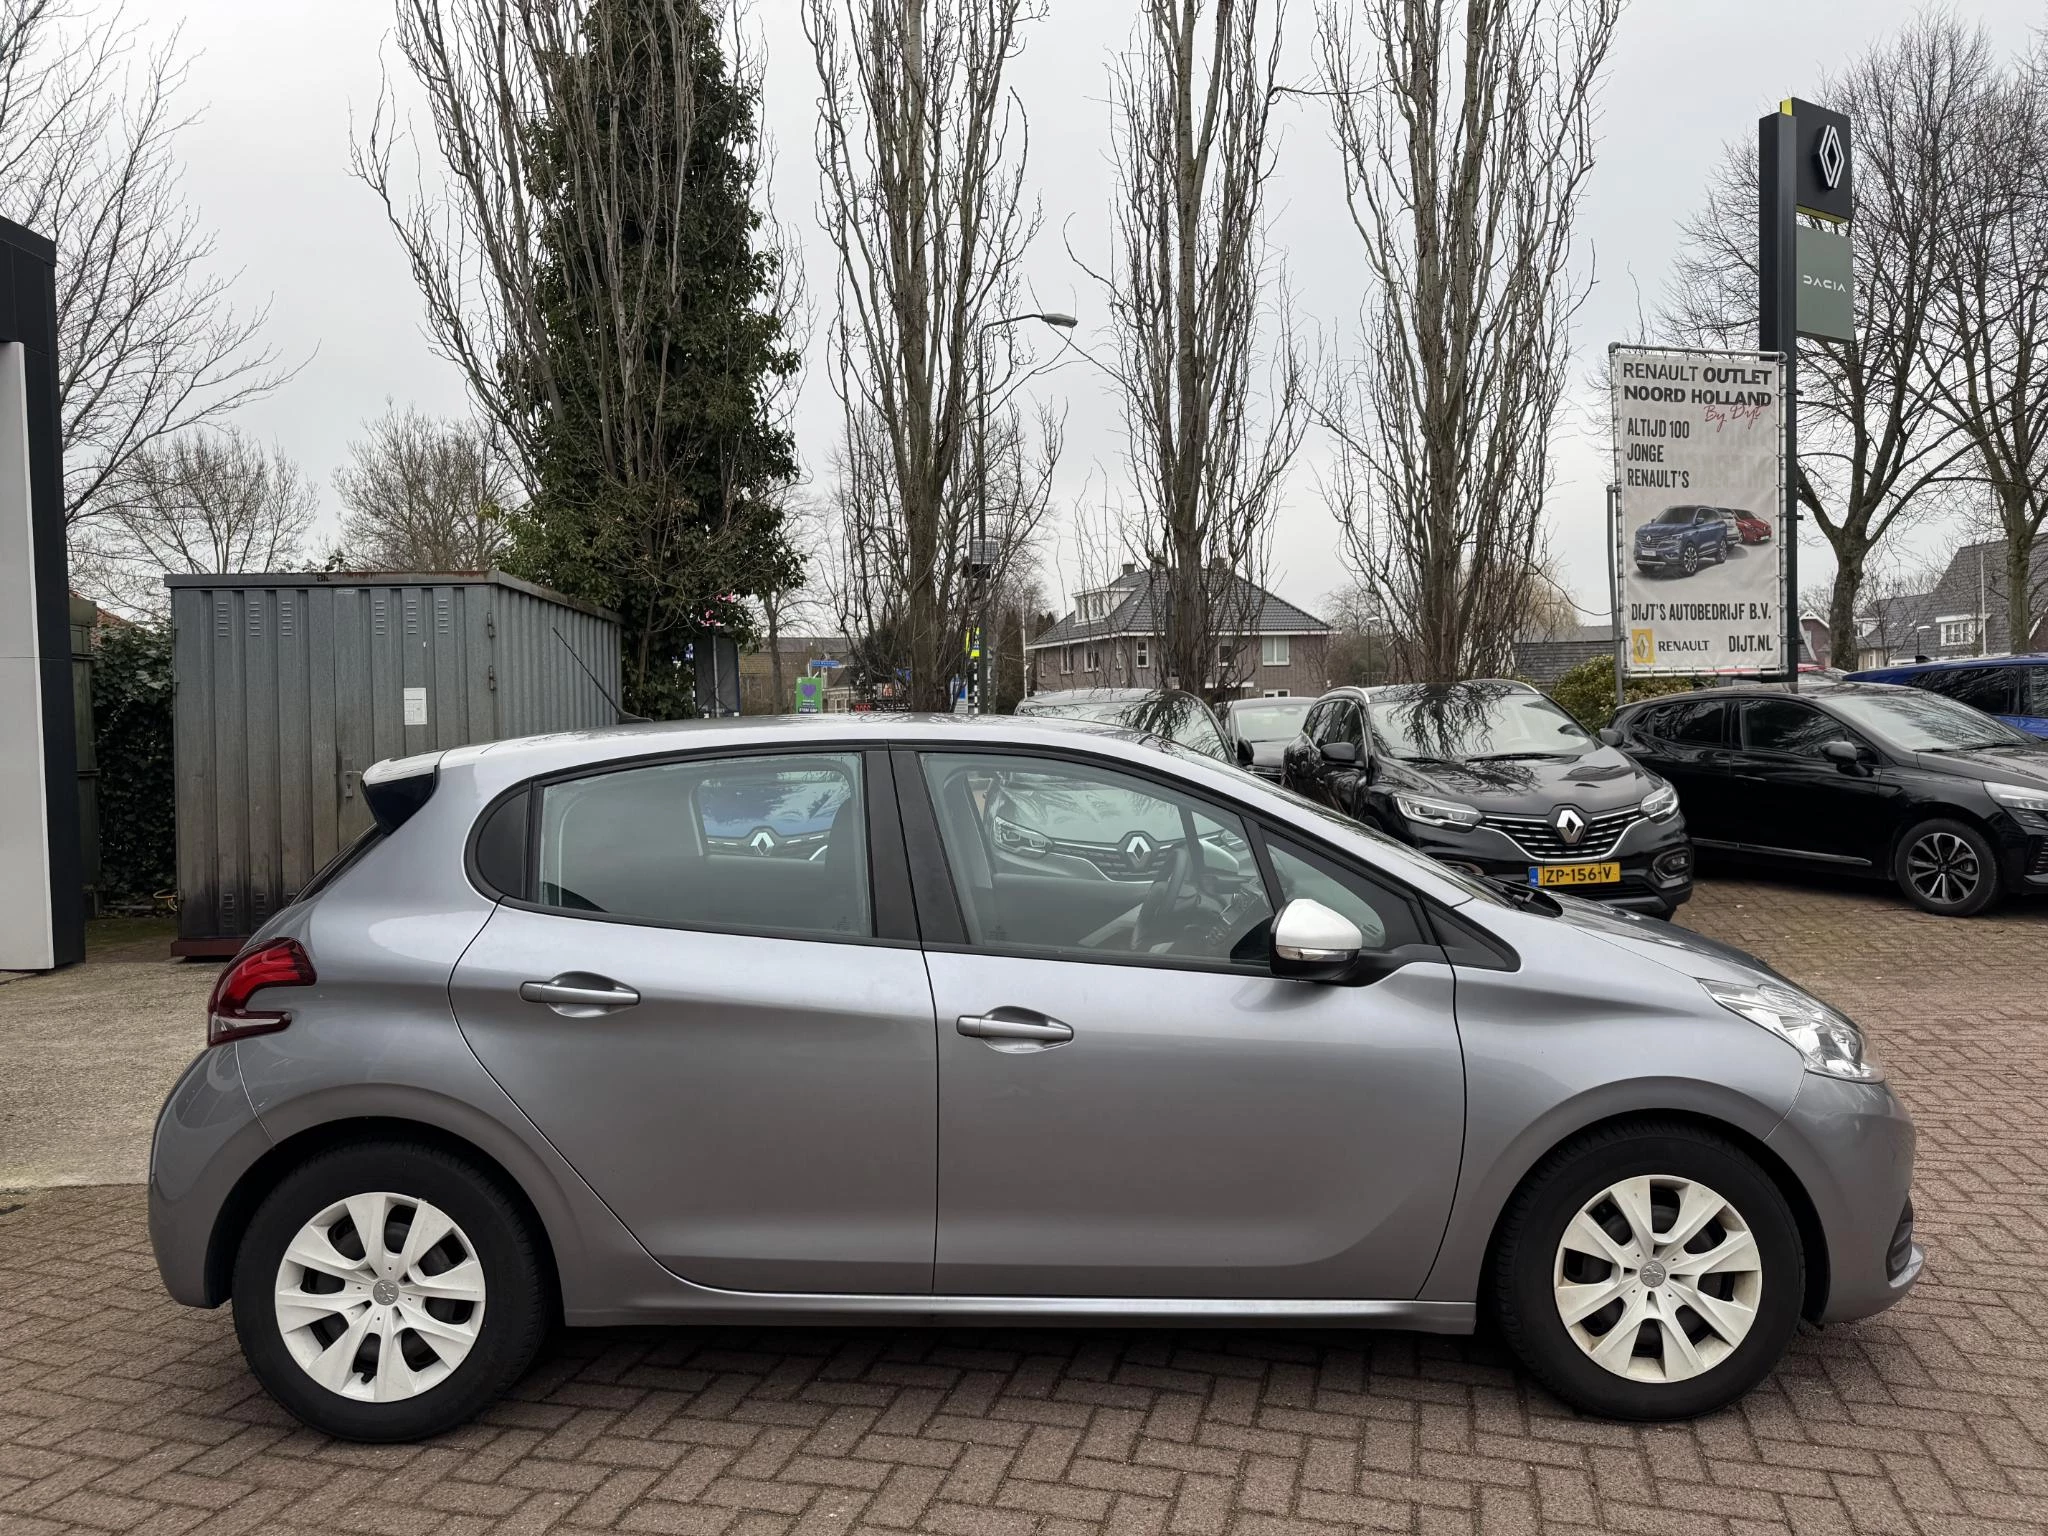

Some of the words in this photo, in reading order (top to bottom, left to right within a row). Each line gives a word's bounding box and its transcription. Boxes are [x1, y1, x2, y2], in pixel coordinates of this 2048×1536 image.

[1803, 274, 1846, 293] DACIA
[1623, 362, 1699, 382] RENAULT
[1703, 366, 1772, 386] OUTLET
[1624, 385, 1686, 403] NOORD
[1691, 388, 1772, 407] HOLLAND
[1627, 417, 1667, 438] ALTIJD
[1669, 420, 1690, 439] 100
[1703, 404, 1727, 433] By
[1627, 443, 1664, 463] JONGE
[1627, 468, 1690, 489] RENAULT'S
[1631, 603, 1667, 621] DIJT'S
[1669, 602, 1746, 621] AUTOBEDRIJF
[1749, 602, 1772, 620] B.V.
[1658, 640, 1710, 652] RENAULT
[1728, 634, 1774, 653] DIJT.NL
[1546, 866, 1612, 883] ZP-156-V
